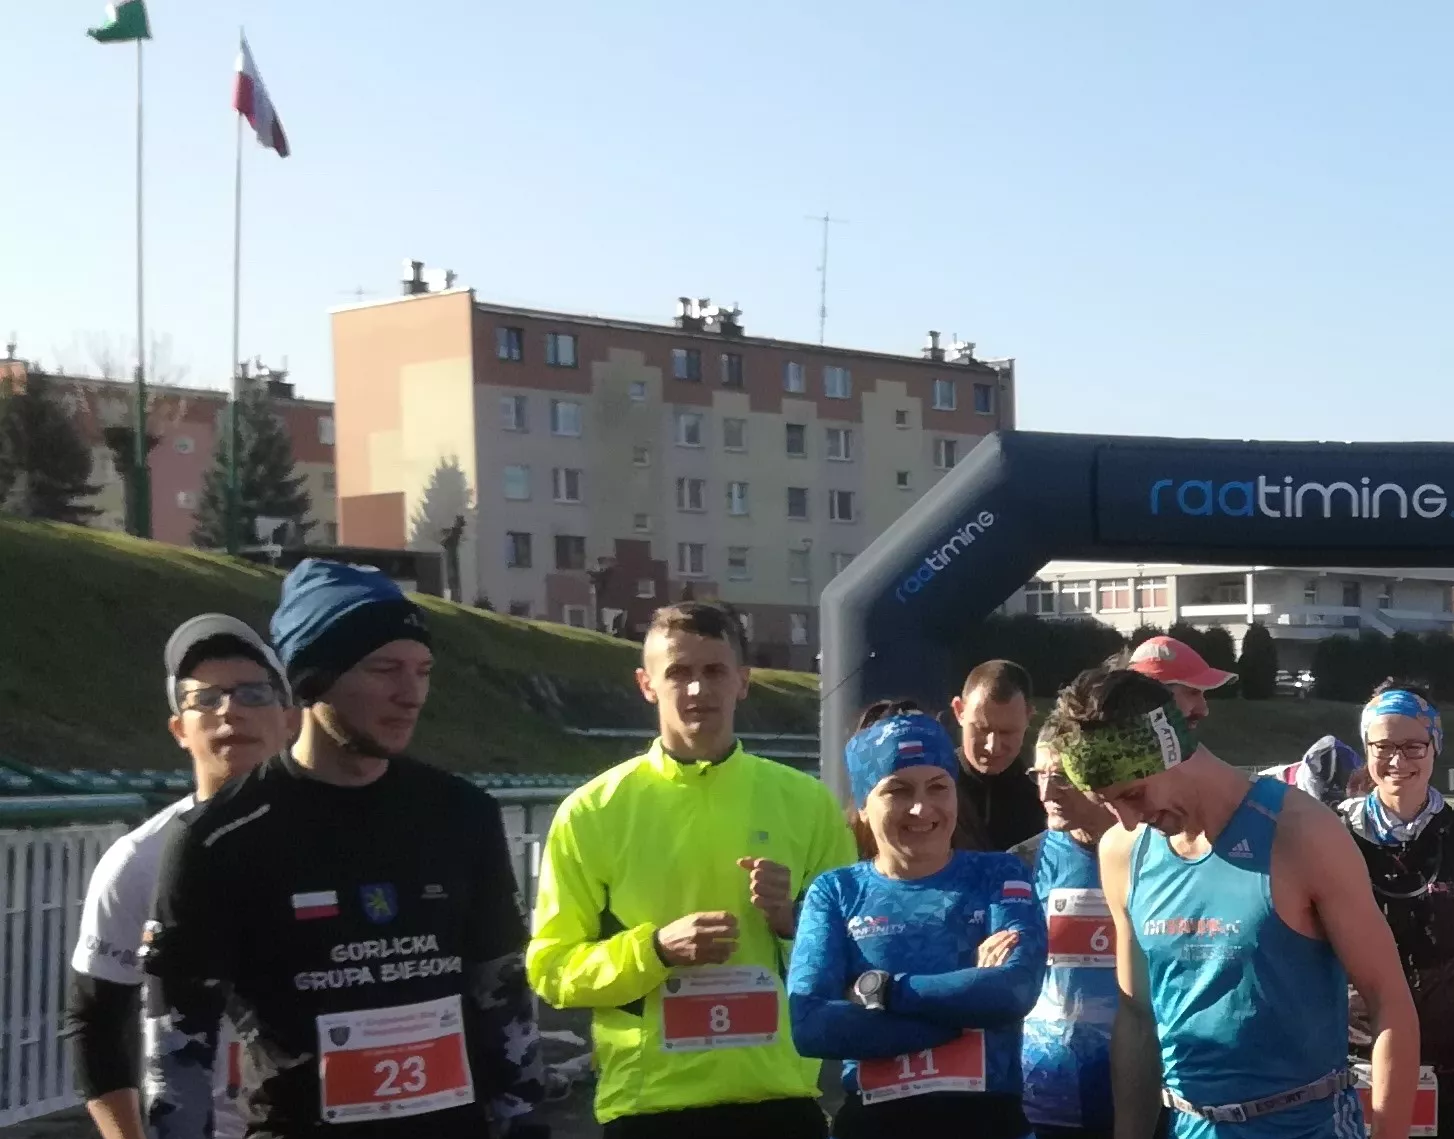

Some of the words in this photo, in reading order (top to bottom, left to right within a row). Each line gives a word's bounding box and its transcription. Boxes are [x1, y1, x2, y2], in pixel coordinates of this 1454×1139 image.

[330, 934, 440, 963] GORLICKA
[1090, 925, 1110, 952] 6
[294, 965, 376, 991] GRUPA
[710, 1004, 731, 1033] 8
[374, 1055, 428, 1097] 23
[895, 1048, 940, 1080] 11
